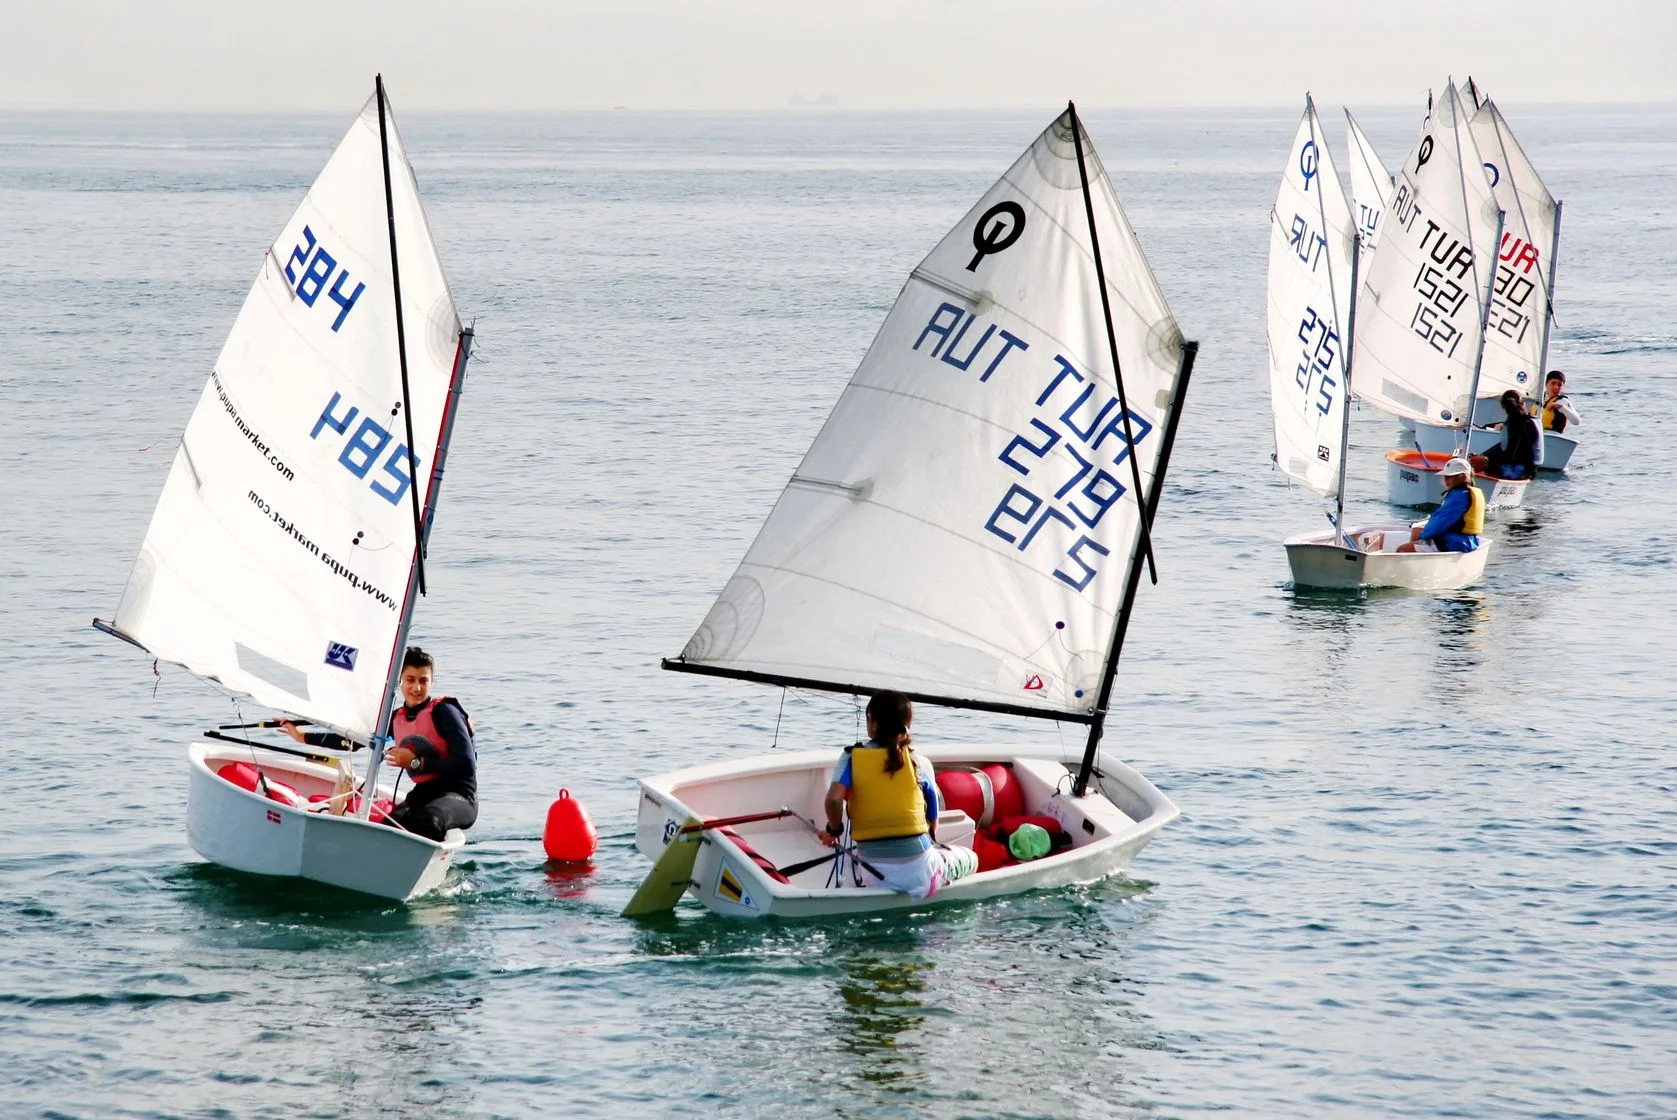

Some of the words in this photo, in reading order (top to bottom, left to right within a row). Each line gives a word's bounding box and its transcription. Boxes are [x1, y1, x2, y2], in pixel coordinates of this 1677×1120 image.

[1360, 203, 1380, 231] TU
[284, 224, 366, 333] 284
[1419, 218, 1476, 280] TUR
[1500, 231, 1540, 275] UR
[1413, 262, 1469, 318] 1521
[1493, 264, 1536, 308] 30
[1298, 306, 1341, 371] 275
[1035, 353, 1153, 466] TUR
[998, 417, 1127, 530] 279
